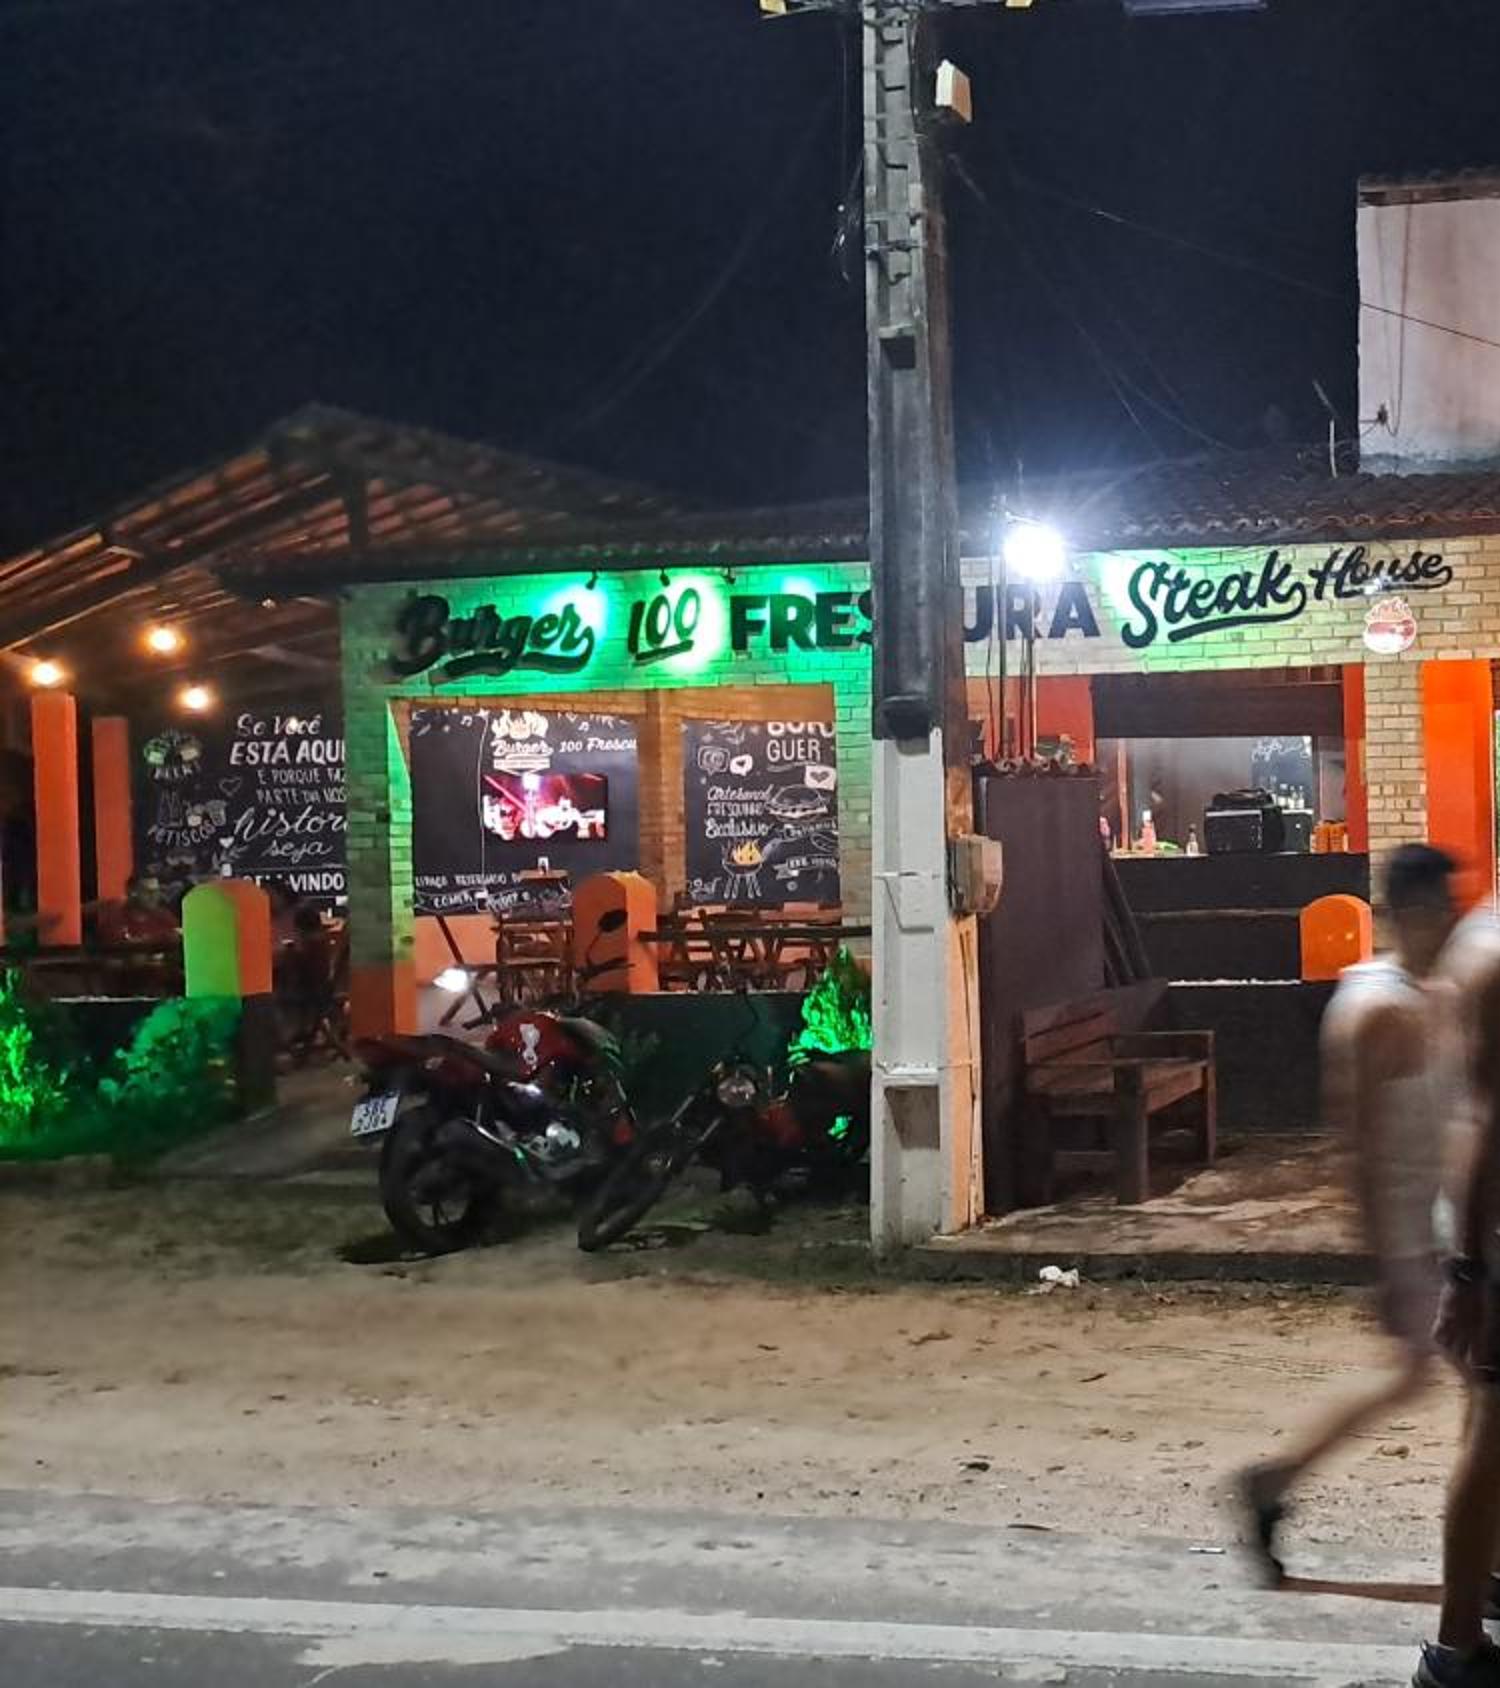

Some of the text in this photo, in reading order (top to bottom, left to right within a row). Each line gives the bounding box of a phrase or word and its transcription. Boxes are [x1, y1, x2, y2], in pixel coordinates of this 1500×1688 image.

[390, 592, 595, 681] Burger
[628, 587, 702, 667] 100
[1121, 545, 1453, 648] Steak House
[766, 738, 822, 762] GUER
